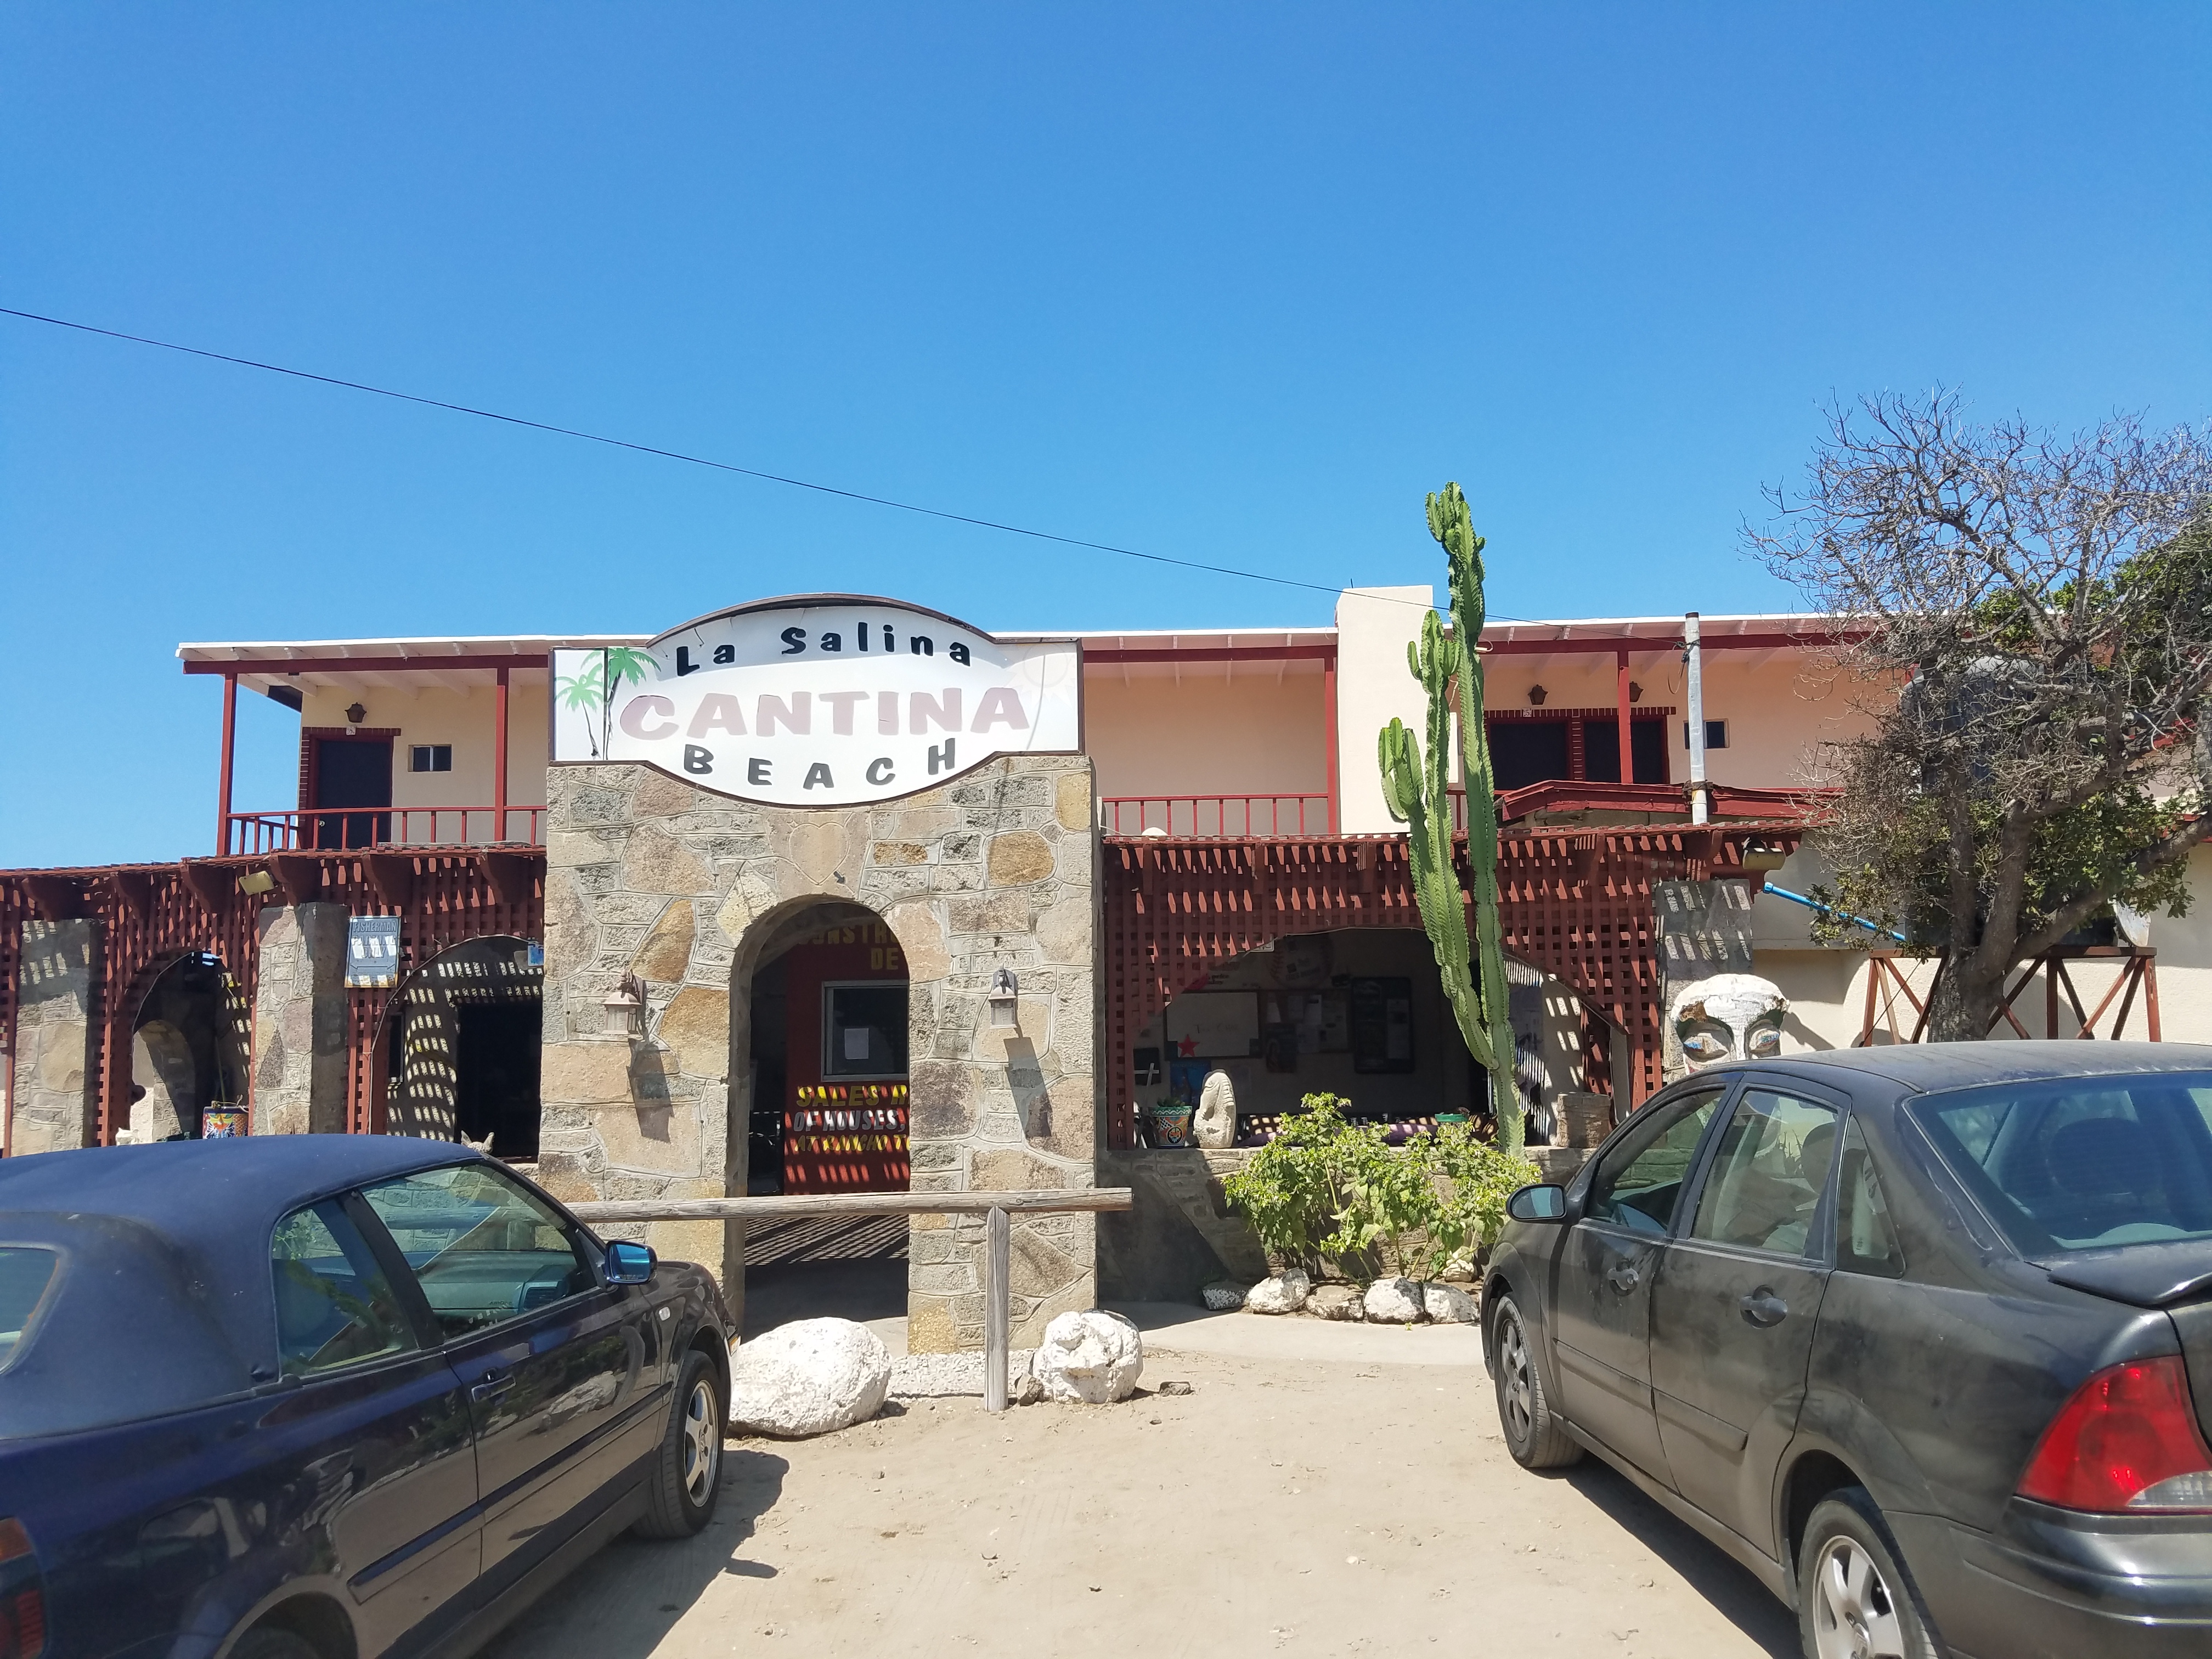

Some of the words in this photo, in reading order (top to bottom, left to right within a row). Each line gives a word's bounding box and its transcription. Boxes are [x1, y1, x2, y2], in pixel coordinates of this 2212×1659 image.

[676, 644, 735, 677] La
[781, 622, 971, 667] Salina
[619, 687, 1030, 741] CANTINA
[684, 738, 956, 791] BEACH
[351, 935, 397, 946] PARKING
[362, 946, 386, 958] ONLY
[871, 947, 899, 970] DE
[796, 1085, 882, 1107] SALES
[890, 1084, 910, 1105] R
[793, 1110, 819, 1132] OF
[822, 1109, 906, 1132] HOUSES,
[794, 1135, 821, 1152] AT
[822, 1134, 888, 1152] RANCHO
